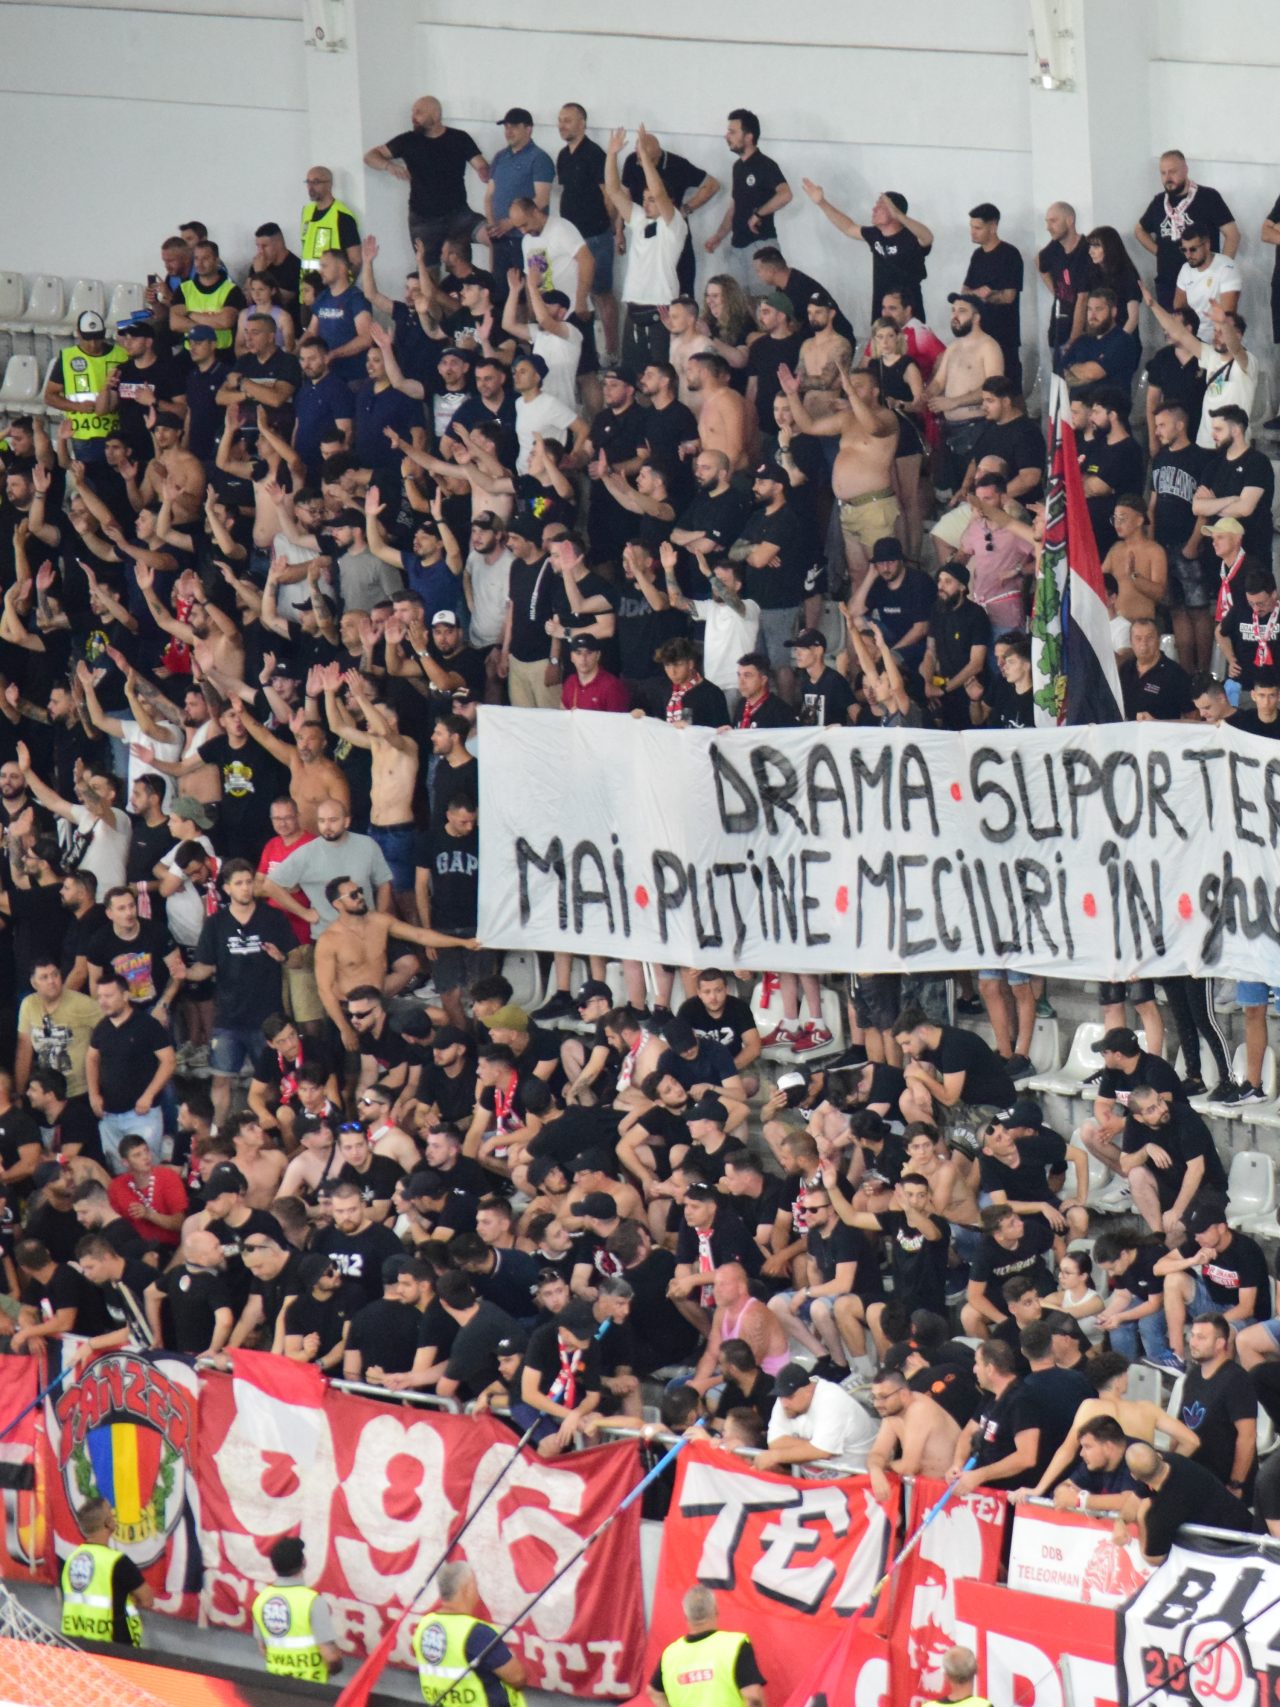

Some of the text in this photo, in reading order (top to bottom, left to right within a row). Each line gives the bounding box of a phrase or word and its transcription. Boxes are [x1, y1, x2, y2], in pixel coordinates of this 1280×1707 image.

[709, 741, 938, 839] DRAMA
[436, 850, 478, 876] GAP
[1017, 1564, 1081, 1588] TELEORMAN
